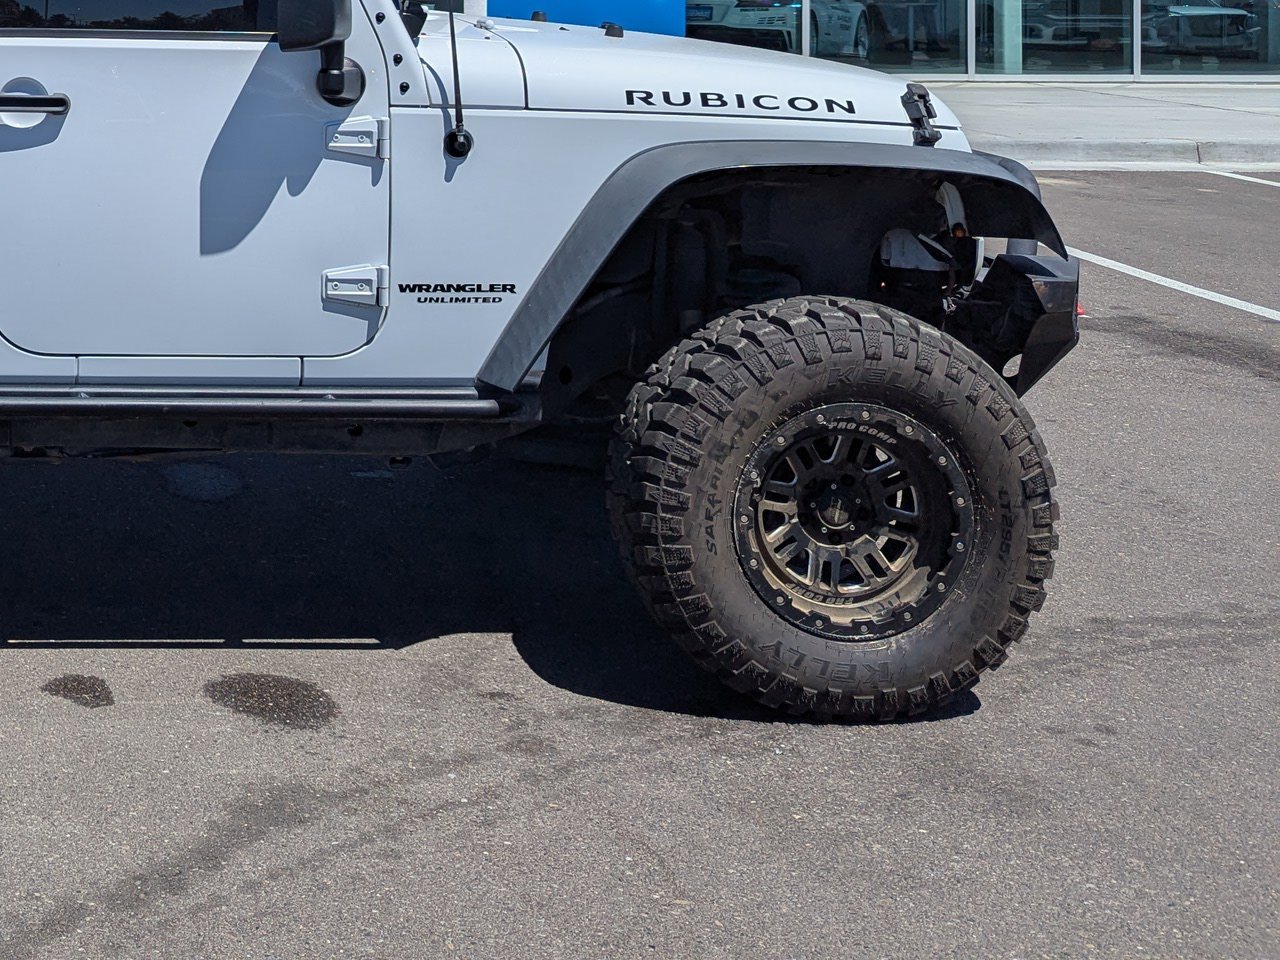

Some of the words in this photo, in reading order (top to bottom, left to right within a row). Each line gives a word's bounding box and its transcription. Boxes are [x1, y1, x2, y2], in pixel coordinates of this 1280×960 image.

[625, 90, 856, 114] RUBICON
[398, 284, 517, 294] WRANGLER
[828, 366, 959, 408] KELLY
[828, 421, 856, 430] PRO
[859, 425, 897, 445] COMP
[785, 583, 824, 602] COMP
[758, 640, 890, 684] KELLY
